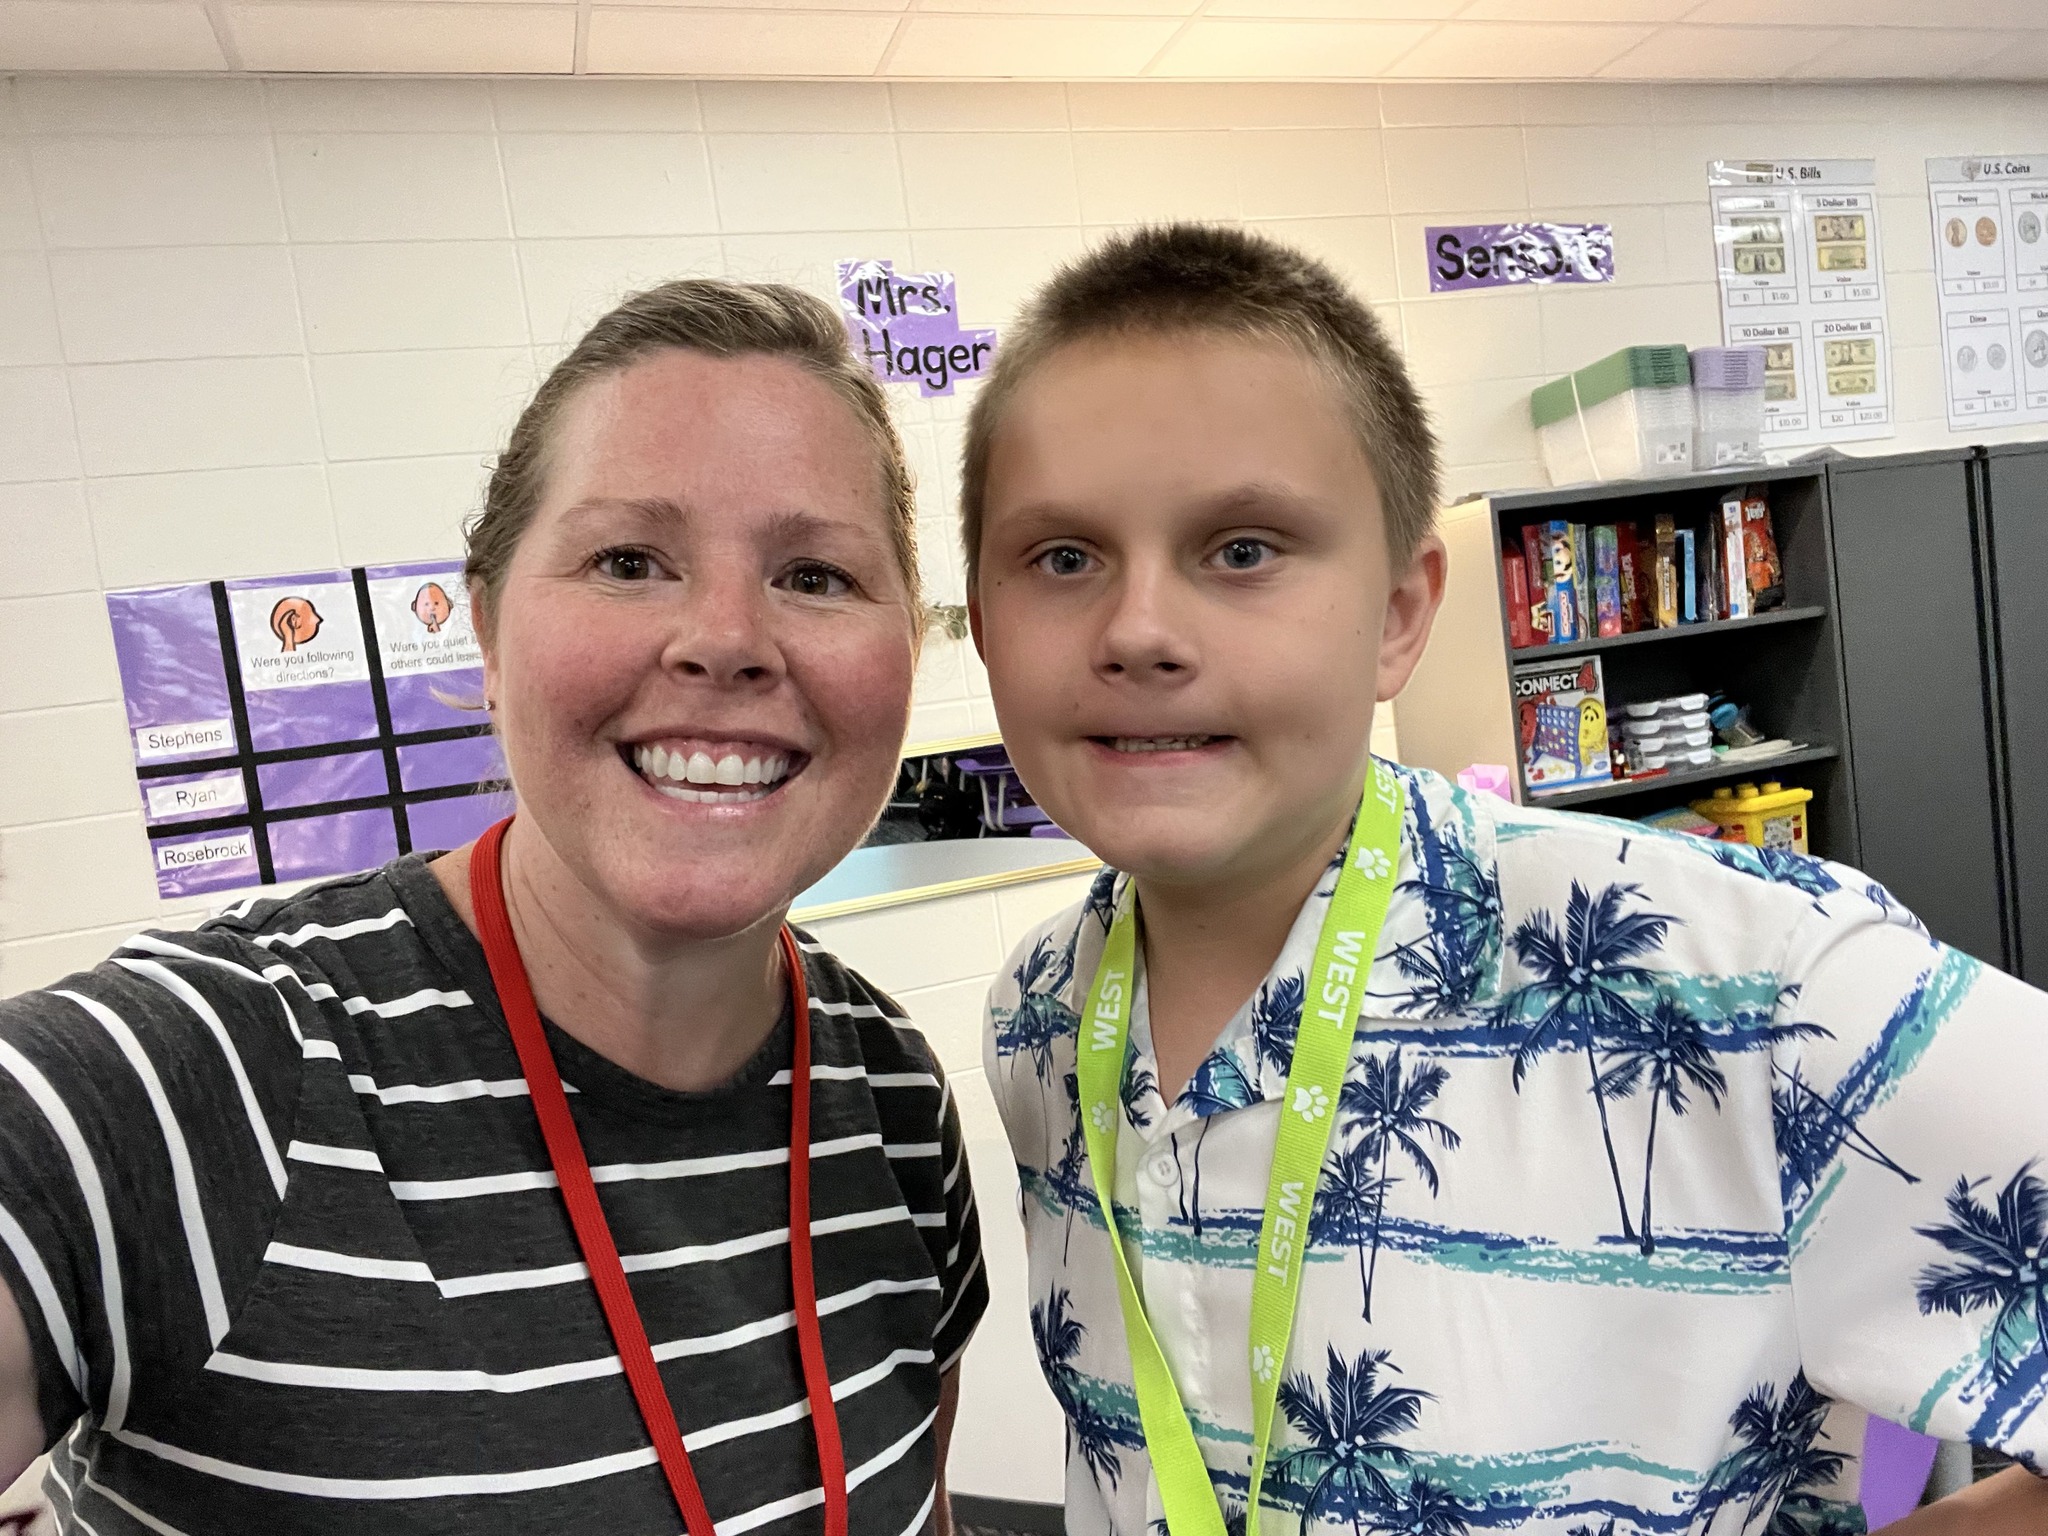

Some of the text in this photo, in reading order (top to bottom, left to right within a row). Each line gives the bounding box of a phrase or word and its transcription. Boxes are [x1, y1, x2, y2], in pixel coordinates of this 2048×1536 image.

[1800, 166, 1821, 179] Bills
[2005, 162, 2030, 174] Coins
[1823, 199, 1845, 207] Dollar
[1846, 198, 1858, 206] Bill
[857, 276, 951, 316] Mrs.
[1743, 327, 1789, 337] 10 Dollar Bill
[1824, 321, 1872, 333] 20 Dollar Bill
[862, 328, 991, 390] Hager
[421, 640, 440, 652] you
[443, 636, 468, 649] quiet
[251, 650, 354, 668] Were you following
[390, 657, 422, 670] others
[426, 653, 454, 665] could
[276, 667, 335, 682] directions?
[149, 729, 223, 749] Stephens
[176, 789, 217, 807] Ryan
[164, 841, 247, 866] Rosebrock
[1318, 931, 1366, 1029] WEST
[1091, 968, 1125, 1051] WEST
[1267, 1181, 1304, 1288] WEST
